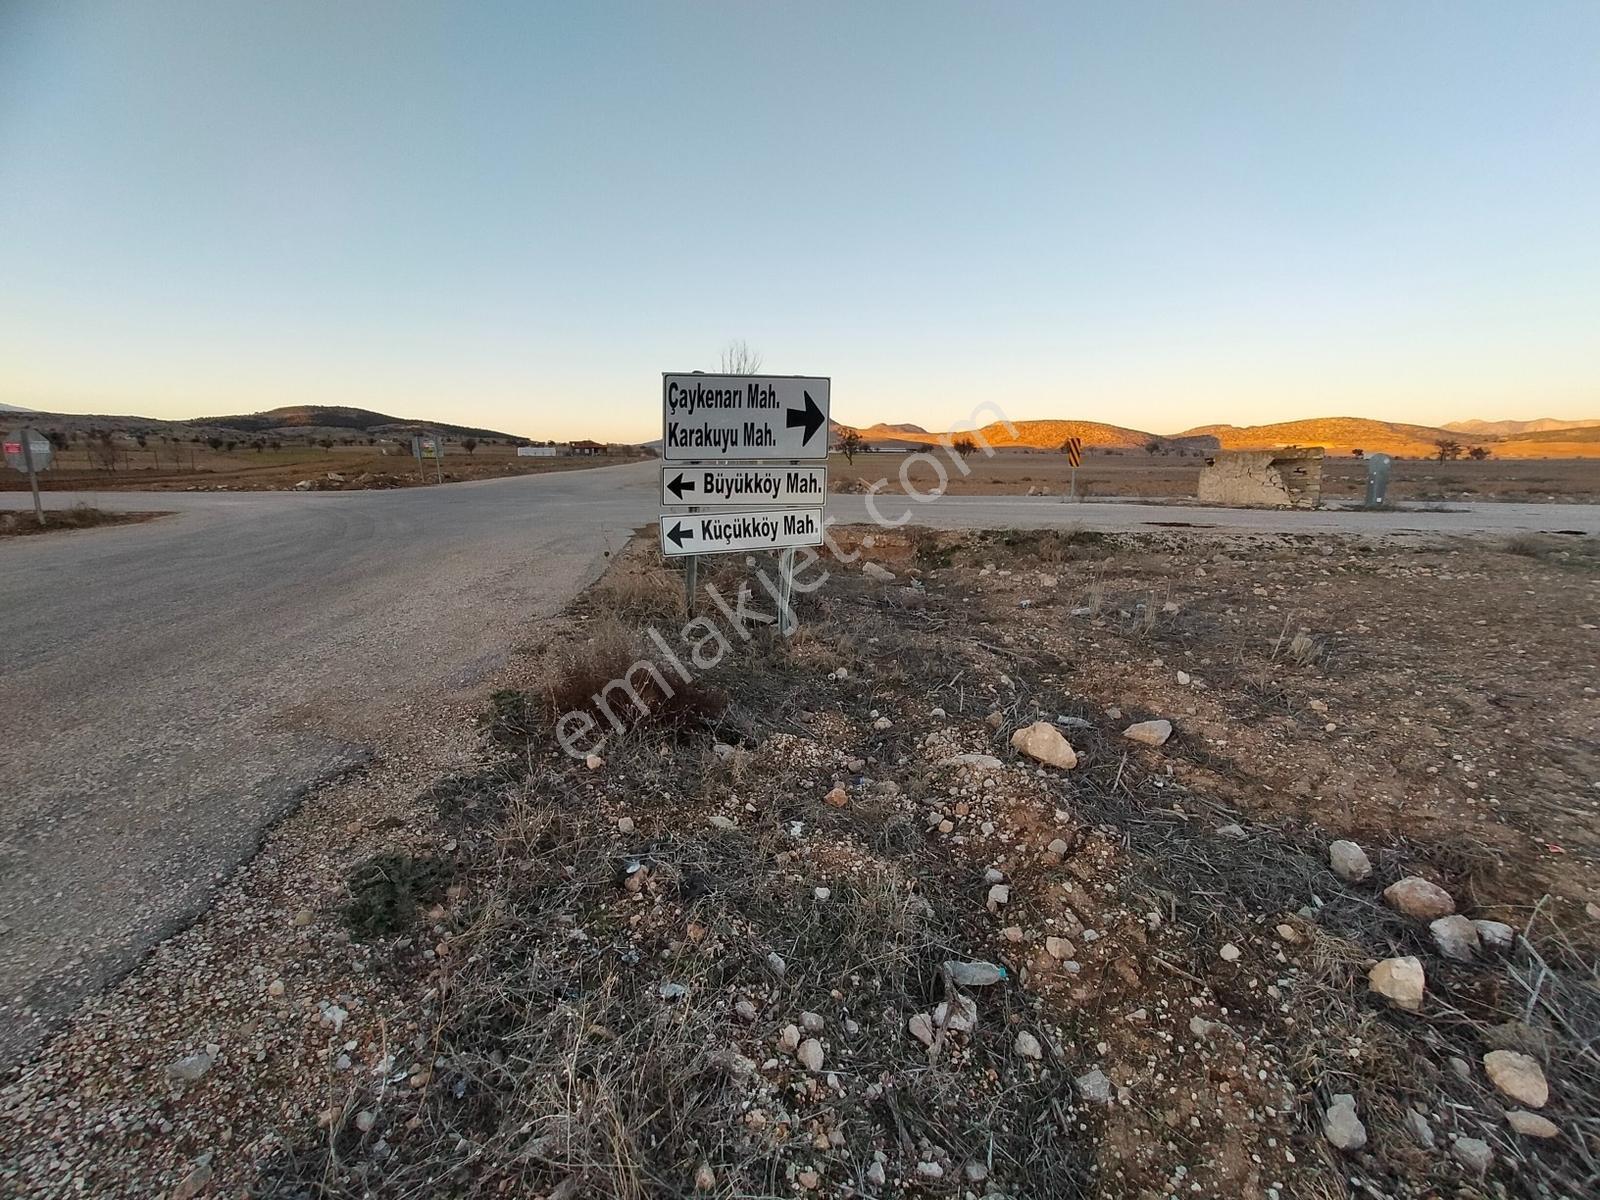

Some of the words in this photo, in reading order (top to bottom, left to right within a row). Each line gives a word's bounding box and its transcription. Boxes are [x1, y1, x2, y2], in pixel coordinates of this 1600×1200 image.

[668, 382, 742, 415] Çaykenarı
[747, 383, 780, 409] Mah.
[668, 422, 738, 453] Karakuyu
[743, 422, 776, 447] Mah.
[704, 472, 781, 499] Büyükköy
[786, 472, 822, 494] Mah.
[701, 517, 779, 544] Küçükköy
[783, 514, 819, 536] Mah.
